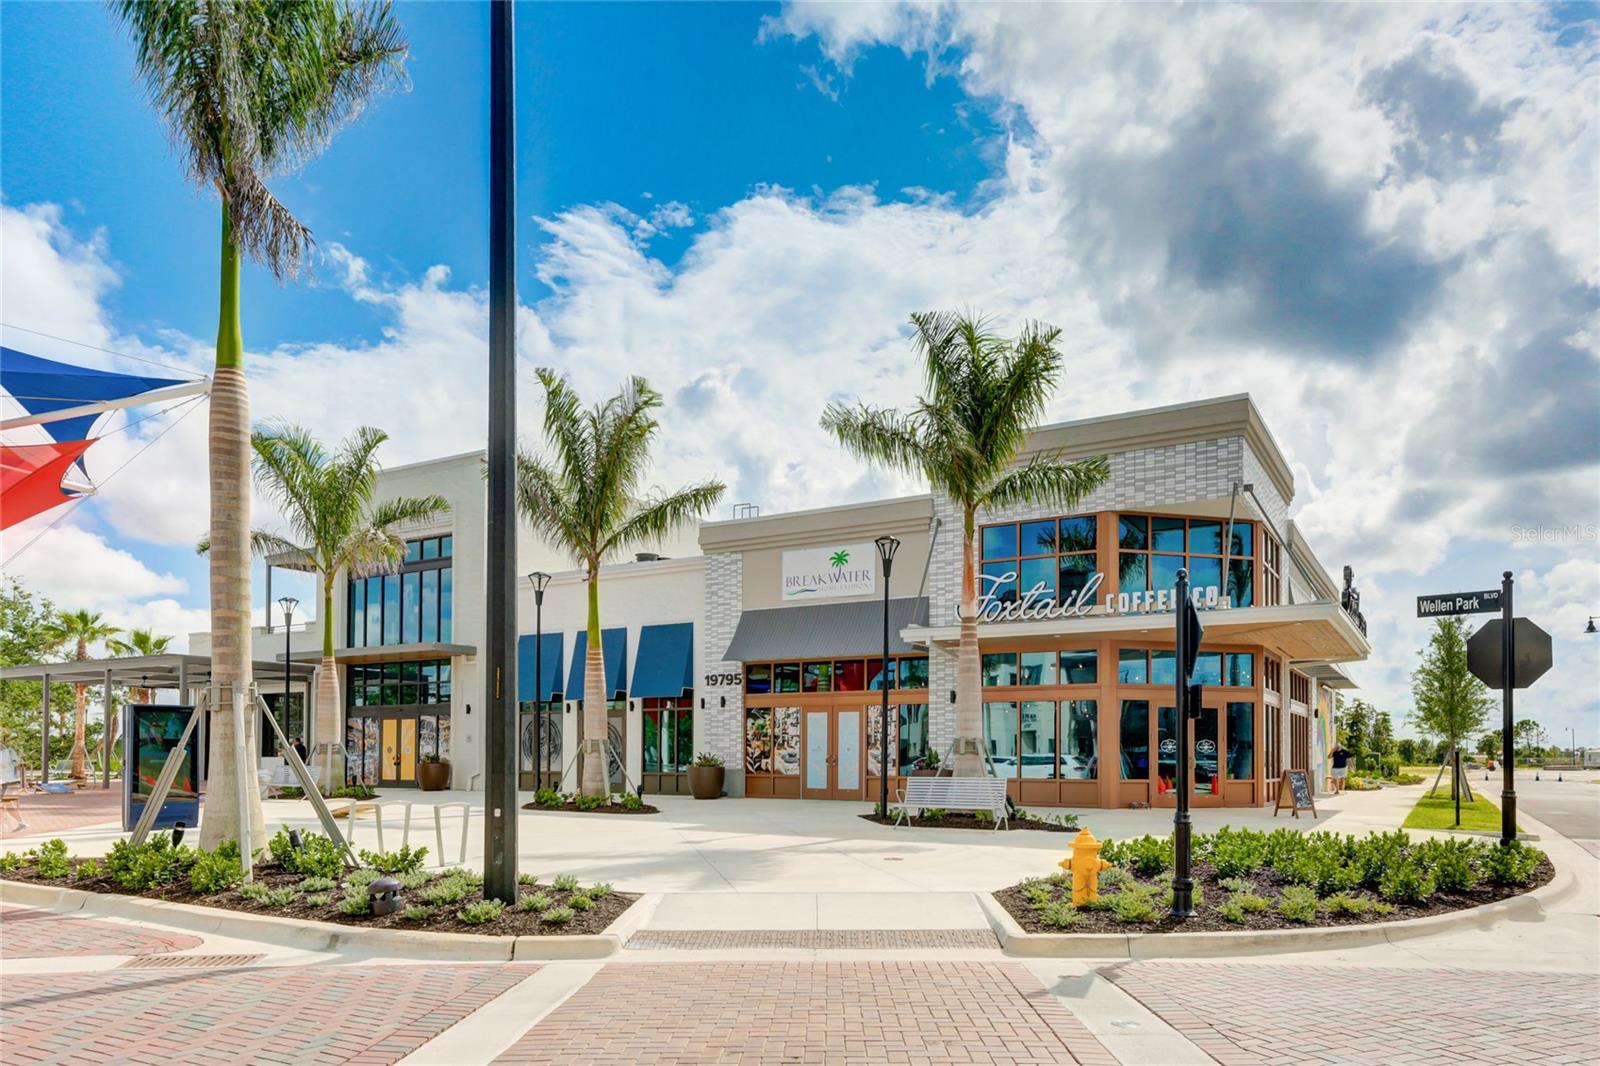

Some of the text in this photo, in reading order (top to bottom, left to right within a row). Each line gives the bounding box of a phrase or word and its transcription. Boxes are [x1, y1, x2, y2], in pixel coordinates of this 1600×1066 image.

[785, 569, 872, 588] BREAKWATER
[957, 571, 1104, 622] Foxtail
[1420, 592, 1499, 613] Wellen Park BLVD
[704, 673, 742, 686] 19795
